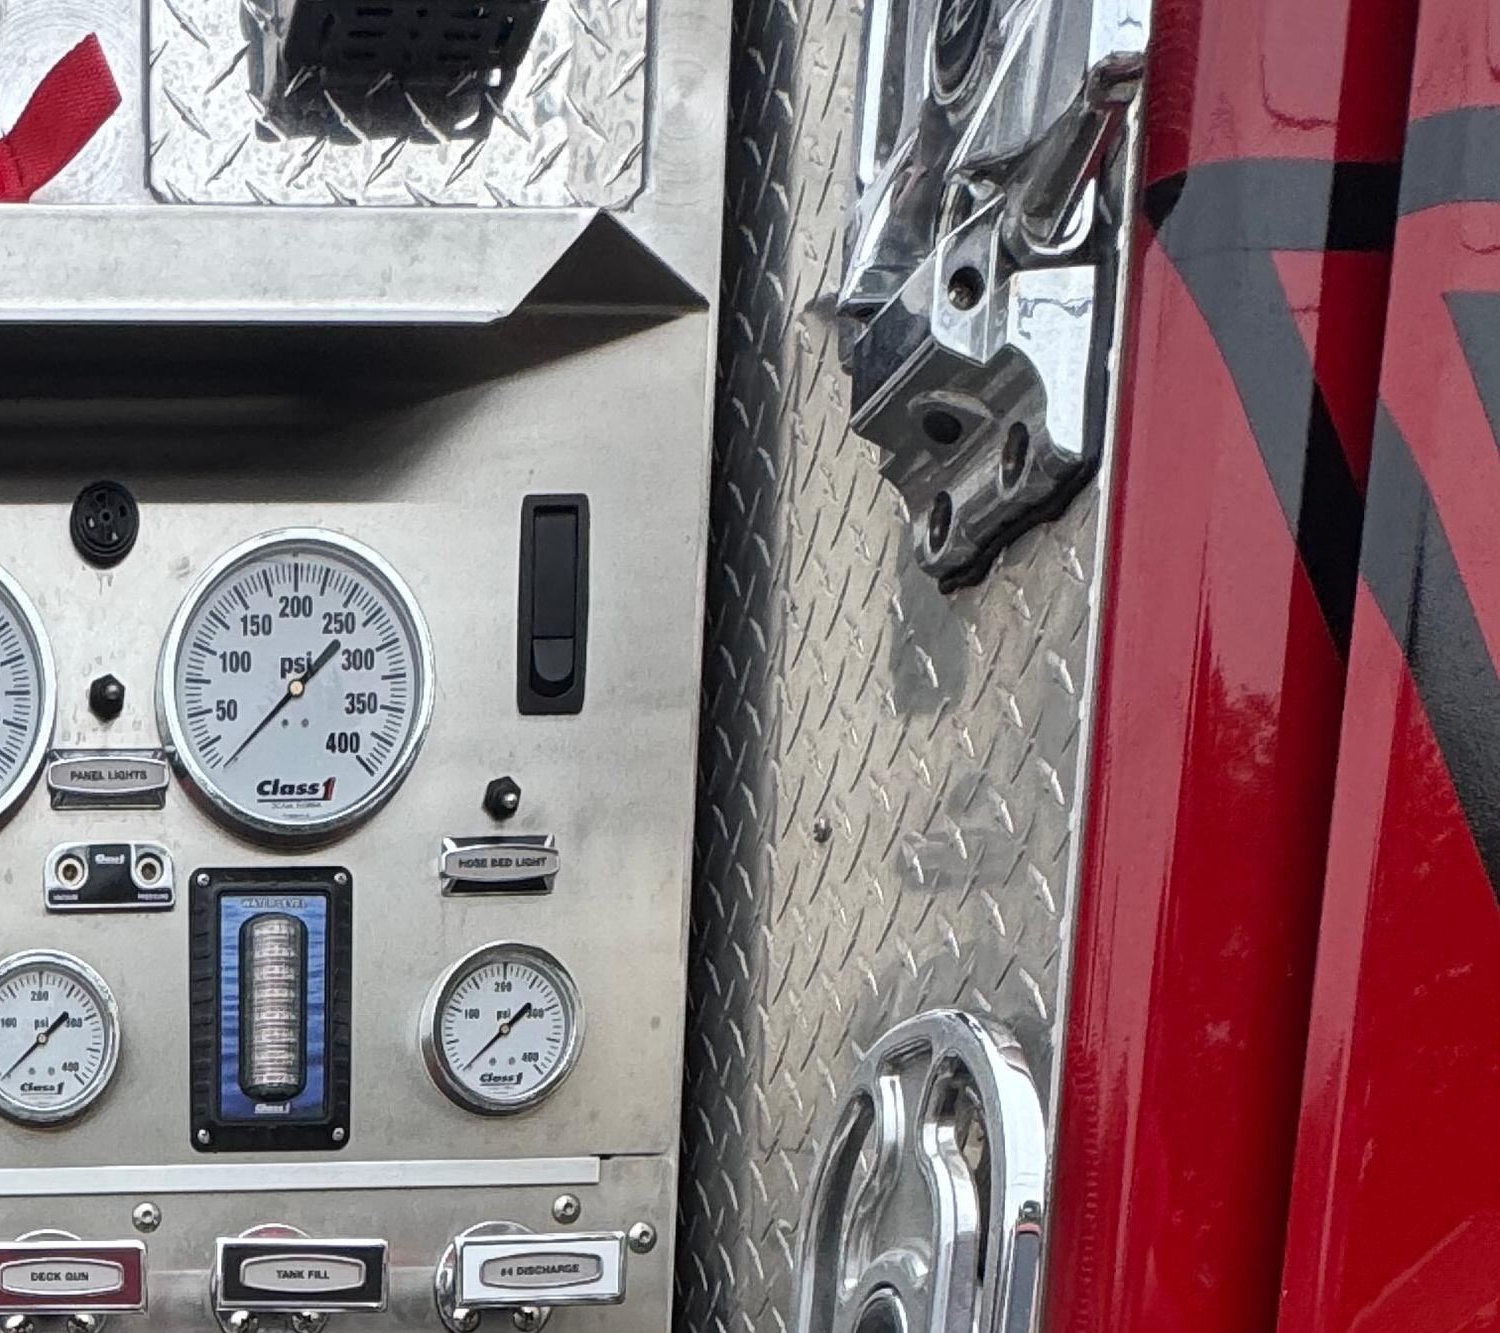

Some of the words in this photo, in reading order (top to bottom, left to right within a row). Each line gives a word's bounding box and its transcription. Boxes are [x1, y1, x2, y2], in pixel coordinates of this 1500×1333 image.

[279, 596, 313, 618] 200
[240, 614, 272, 636] 150
[322, 612, 356, 634] 250
[219, 651, 251, 673] 100
[280, 651, 313, 679] psi
[341, 649, 375, 671] 300
[216, 699, 238, 721] 50
[344, 692, 377, 715] 350
[326, 732, 360, 753] 400
[70, 770, 104, 781] PANEL
[108, 770, 147, 780] LIGHTS
[459, 859, 487, 869] HOSE
[491, 858, 512, 868] BED
[516, 857, 547, 867] LIGHT
[31, 1271, 61, 1282] DECK
[65, 1271, 89, 1281] GUN
[276, 1270, 305, 1280] TANK
[308, 1270, 330, 1280] FILL
[516, 1264, 580, 1276] DISCHARGE
